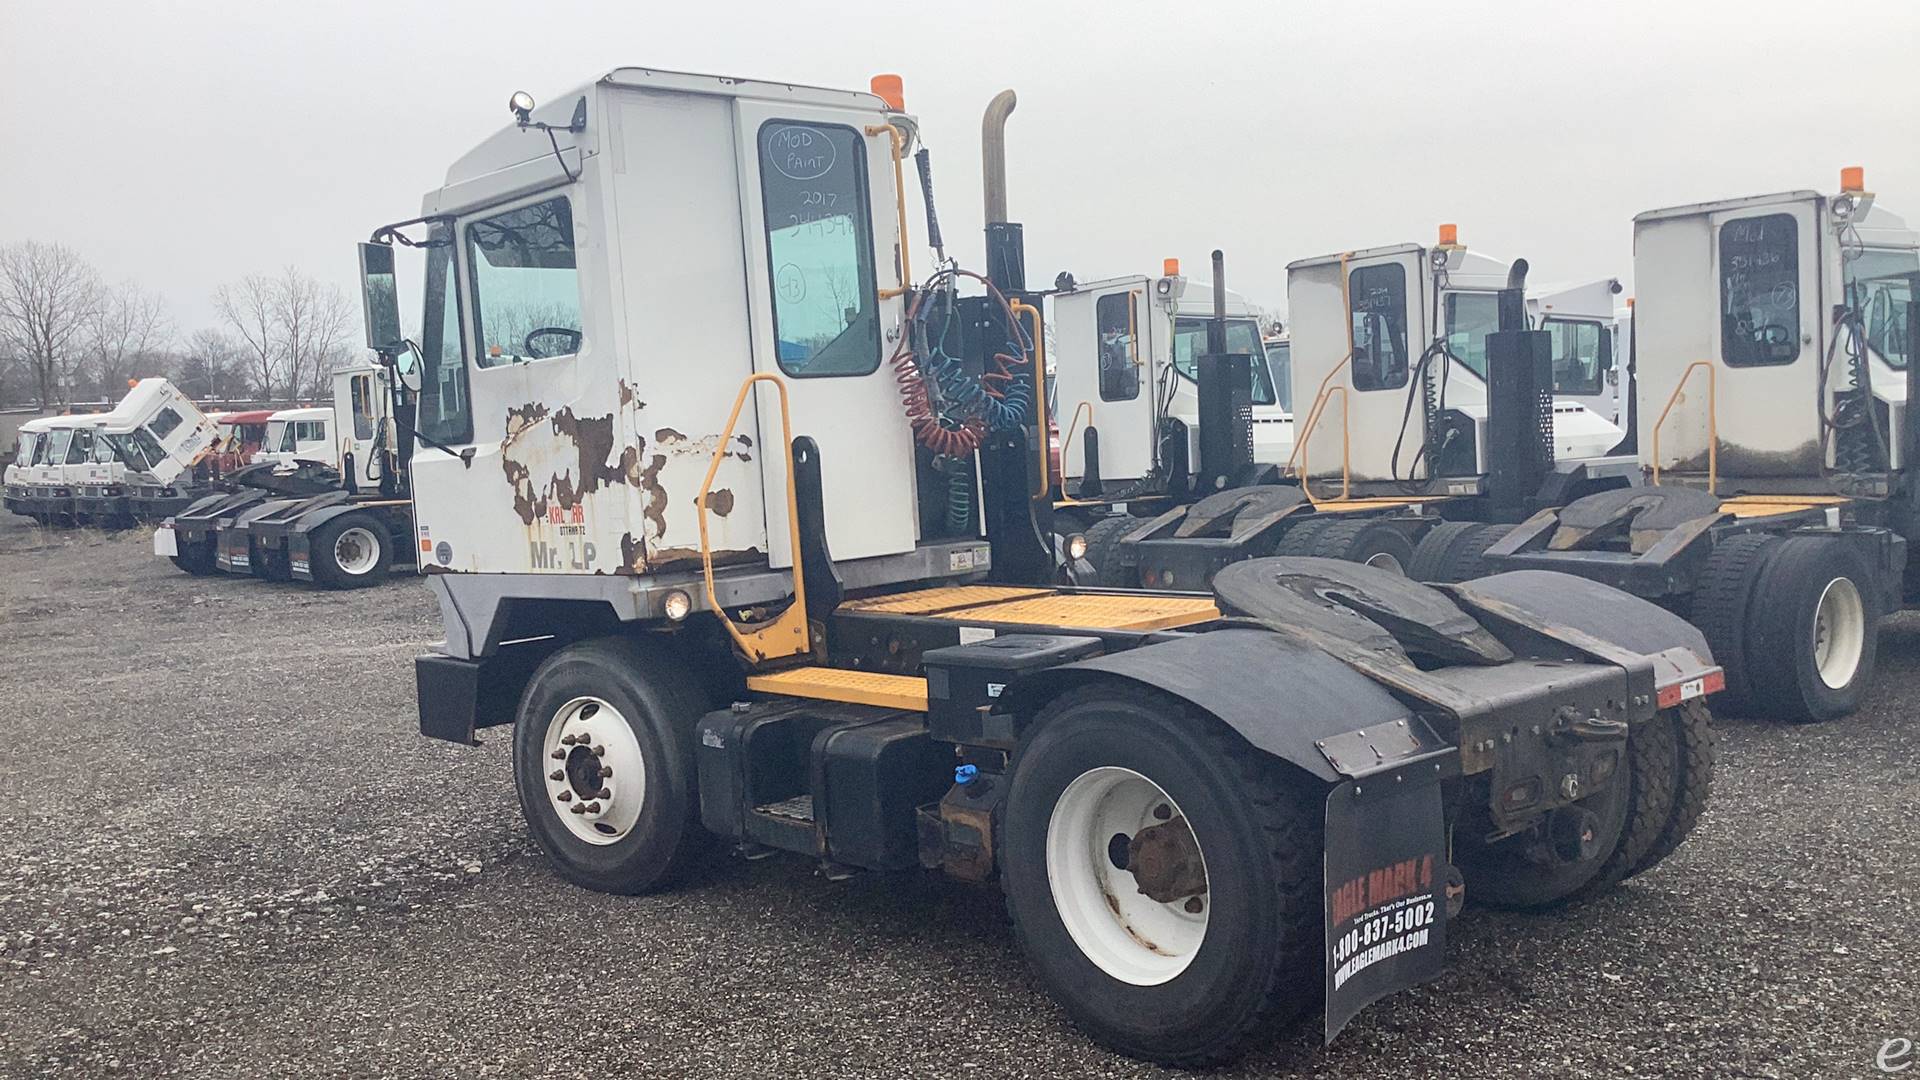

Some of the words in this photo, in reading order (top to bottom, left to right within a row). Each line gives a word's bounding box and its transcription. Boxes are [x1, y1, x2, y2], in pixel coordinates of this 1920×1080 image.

[778, 131, 814, 149] MOD
[799, 190, 838, 208] 2017
[549, 503, 585, 525] KALAR
[1369, 860, 1418, 907] MARK
[1332, 901, 1435, 969] 1-800-837-5002
[1334, 928, 1429, 992] WWW.EAGLEMARK4.COM
